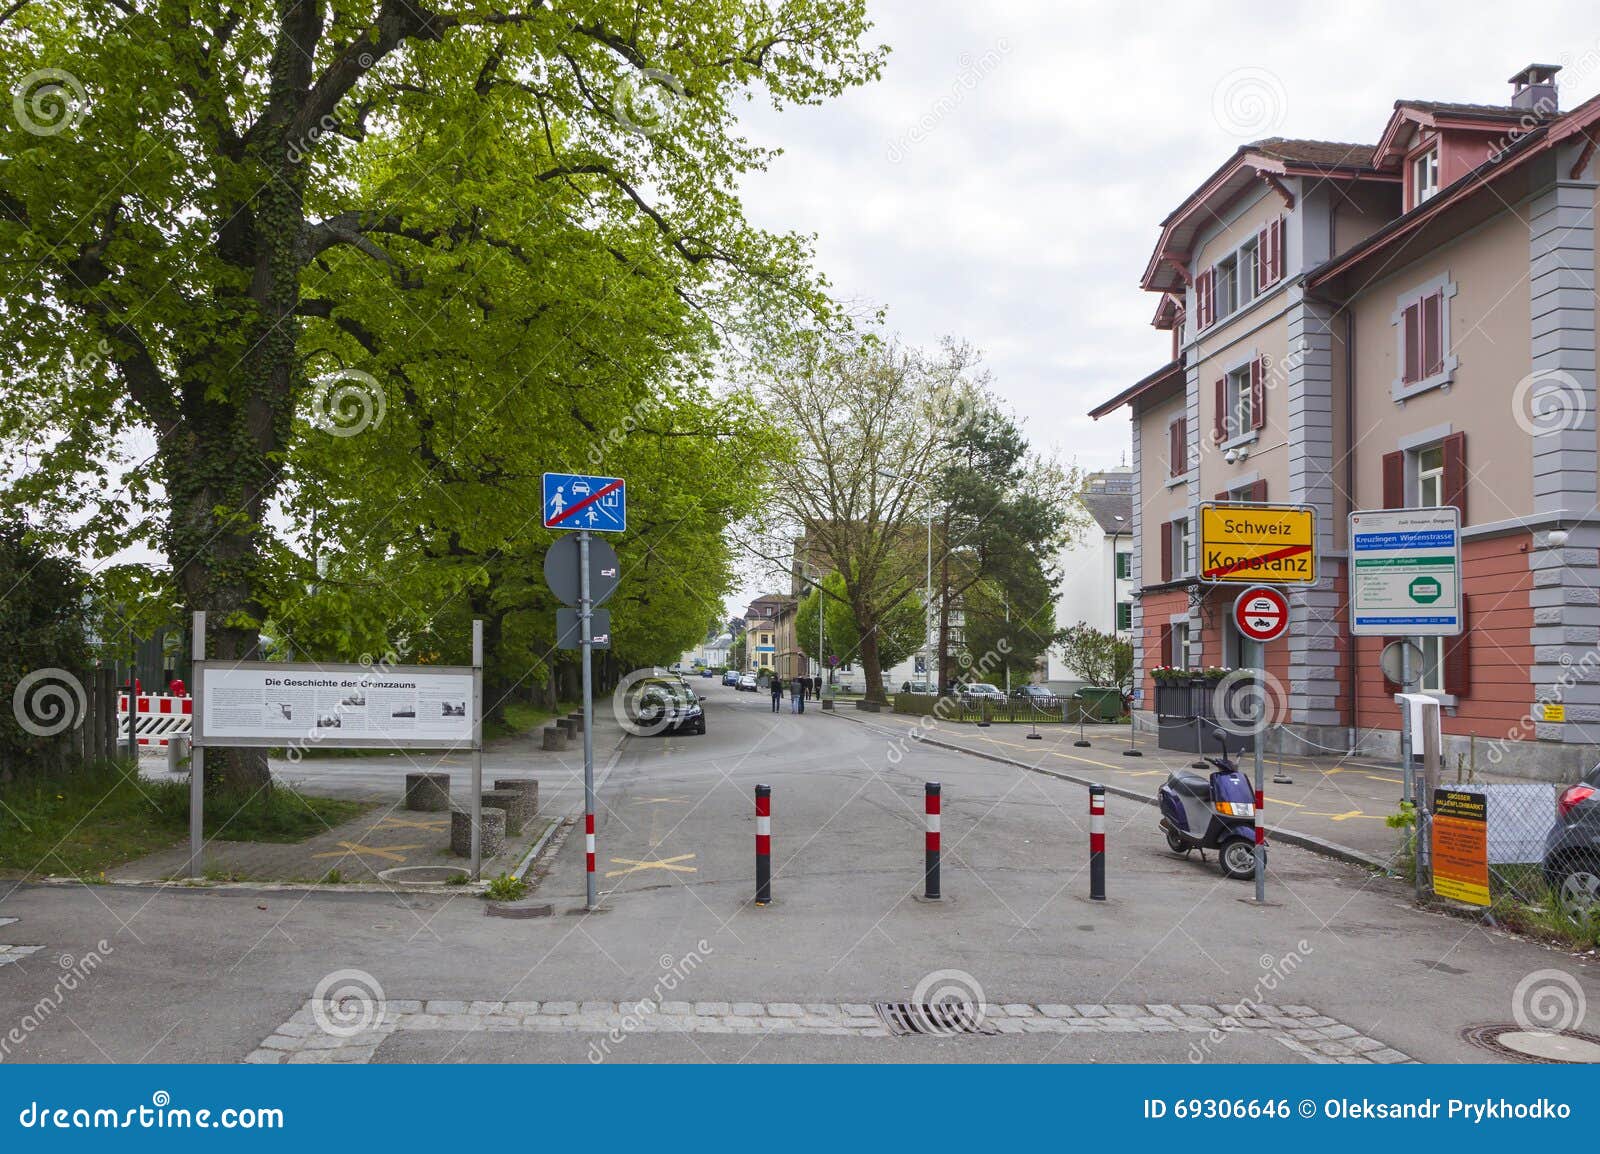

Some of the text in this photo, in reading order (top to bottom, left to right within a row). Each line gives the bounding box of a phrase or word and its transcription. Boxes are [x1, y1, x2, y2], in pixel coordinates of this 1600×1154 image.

[1224, 519, 1291, 535] Schweiz
[1356, 533, 1453, 544] Kreuzlingen Wiesenstrasse
[1208, 551, 1308, 572] Konstanz
[265, 678, 416, 689] Die Geschichte des Grenzzauns
